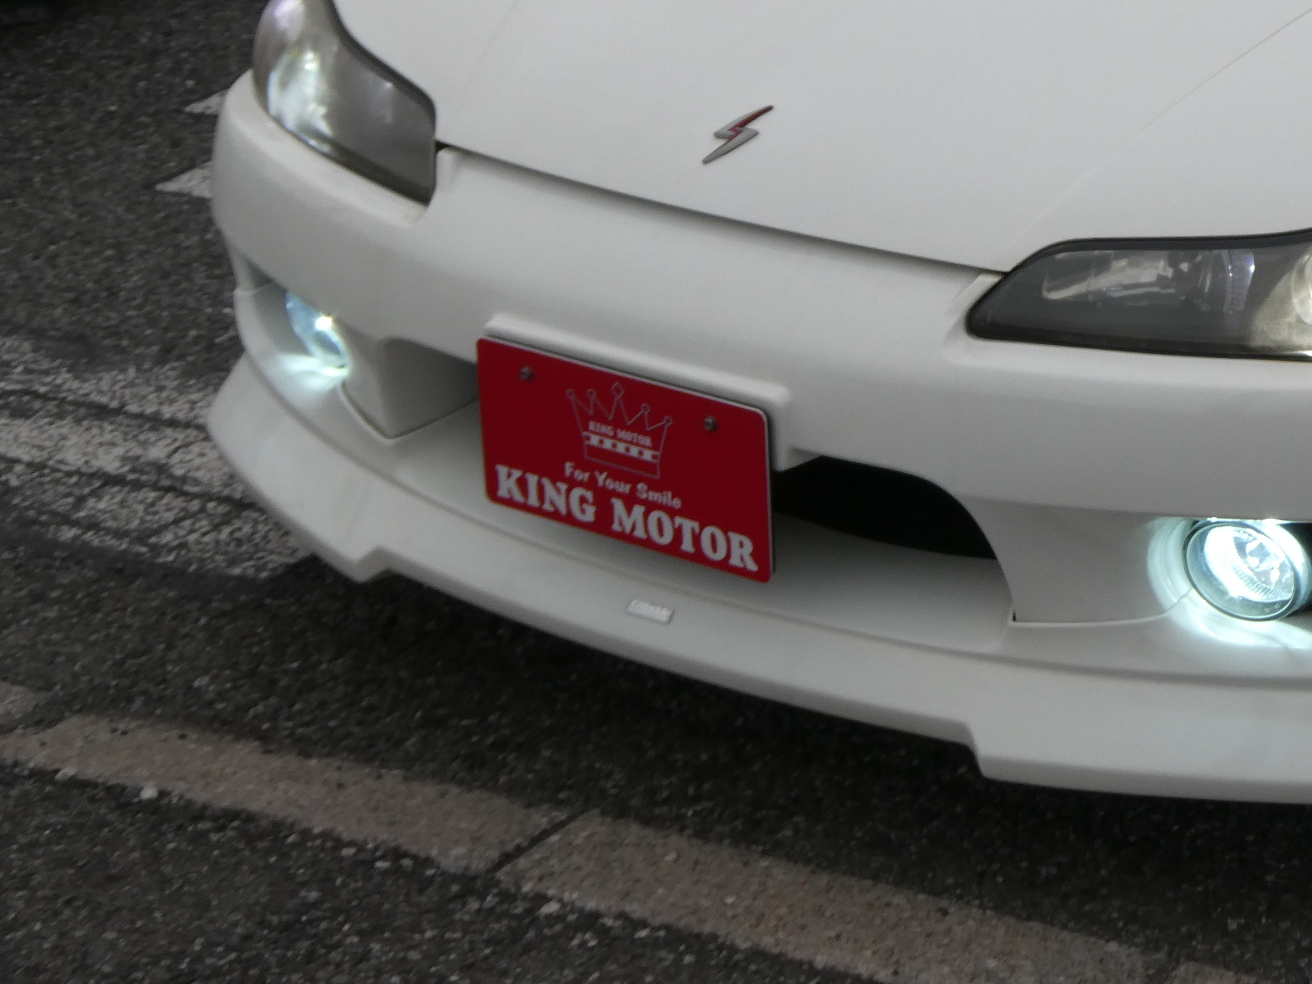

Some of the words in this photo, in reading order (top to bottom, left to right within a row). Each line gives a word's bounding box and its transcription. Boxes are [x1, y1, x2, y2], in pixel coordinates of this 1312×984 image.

[588, 420, 614, 436] KING
[616, 428, 652, 447] MOTOR
[564, 461, 590, 483] For
[594, 469, 631, 495] Your
[637, 482, 682, 509] Smile
[495, 464, 597, 523] KING
[611, 497, 758, 572] MOTOR
